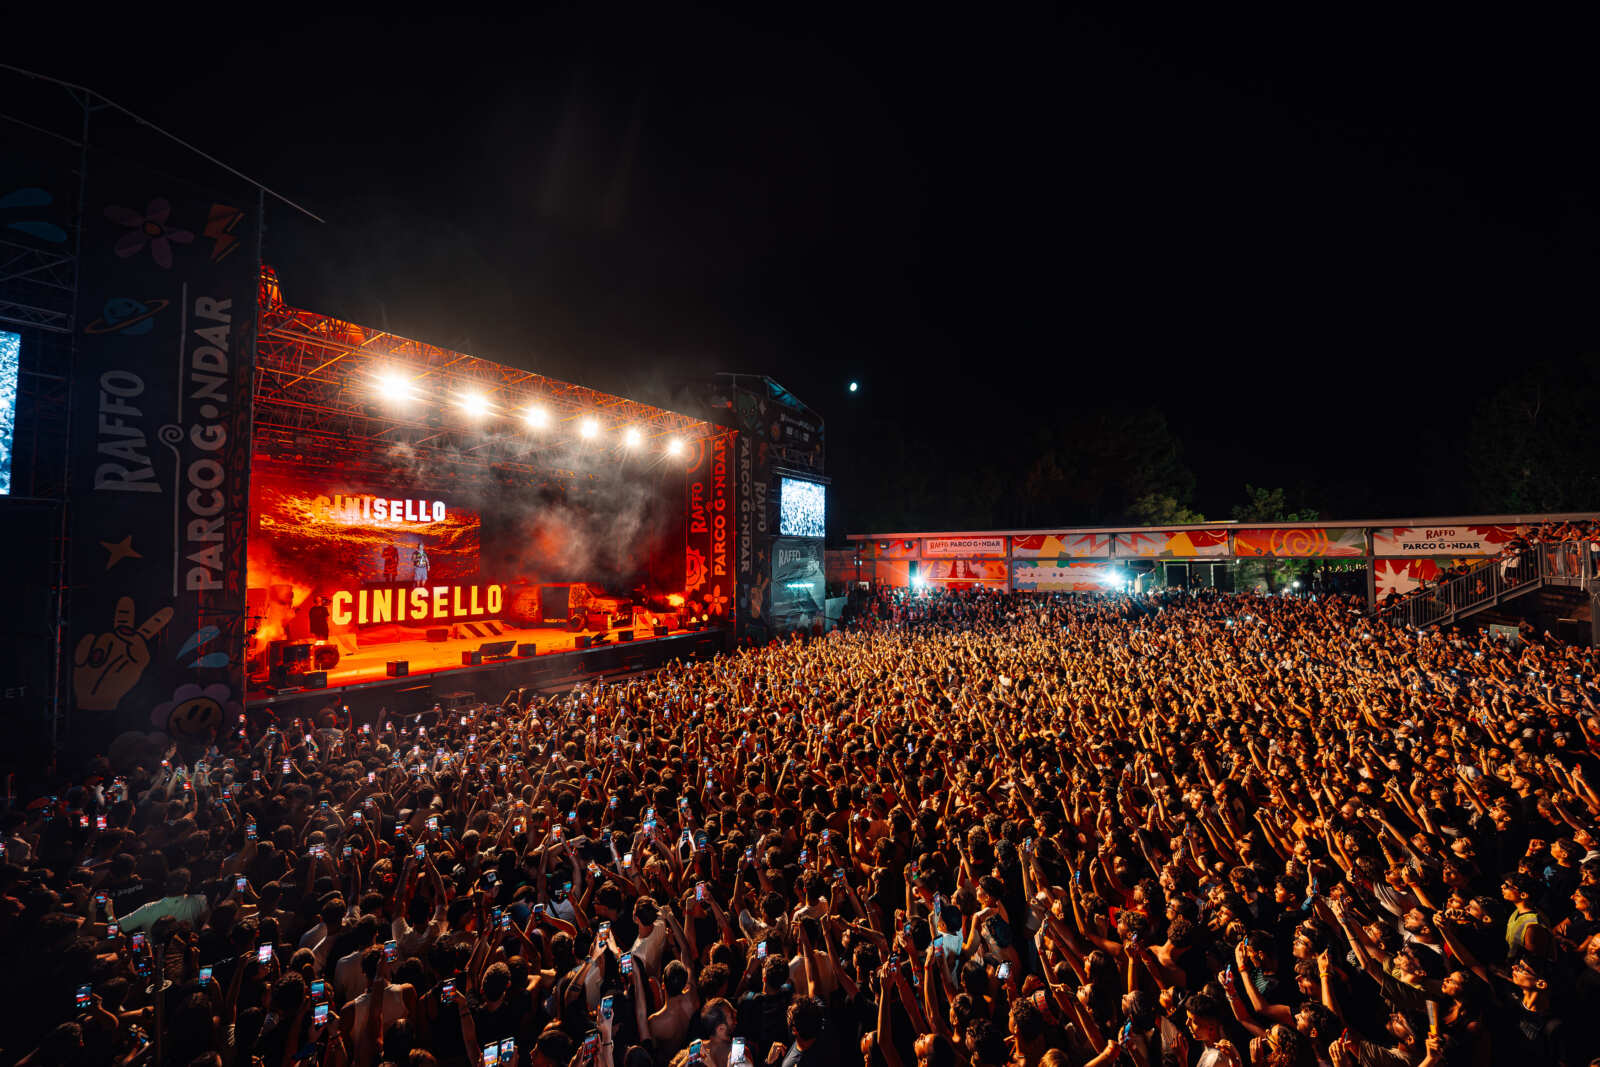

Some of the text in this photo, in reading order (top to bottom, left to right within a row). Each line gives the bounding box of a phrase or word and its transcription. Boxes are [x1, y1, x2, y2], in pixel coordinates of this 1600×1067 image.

[94, 369, 162, 494] RAFFO
[740, 436, 750, 497] PARCO
[186, 458, 225, 591] PARCO
[313, 495, 446, 524] CINISELLO
[690, 482, 708, 533] RAFFO
[754, 481, 768, 532] RAFFO
[714, 514, 727, 576] PARCO
[1426, 529, 1455, 540] RAFFO
[332, 584, 502, 626] CINISELLO
